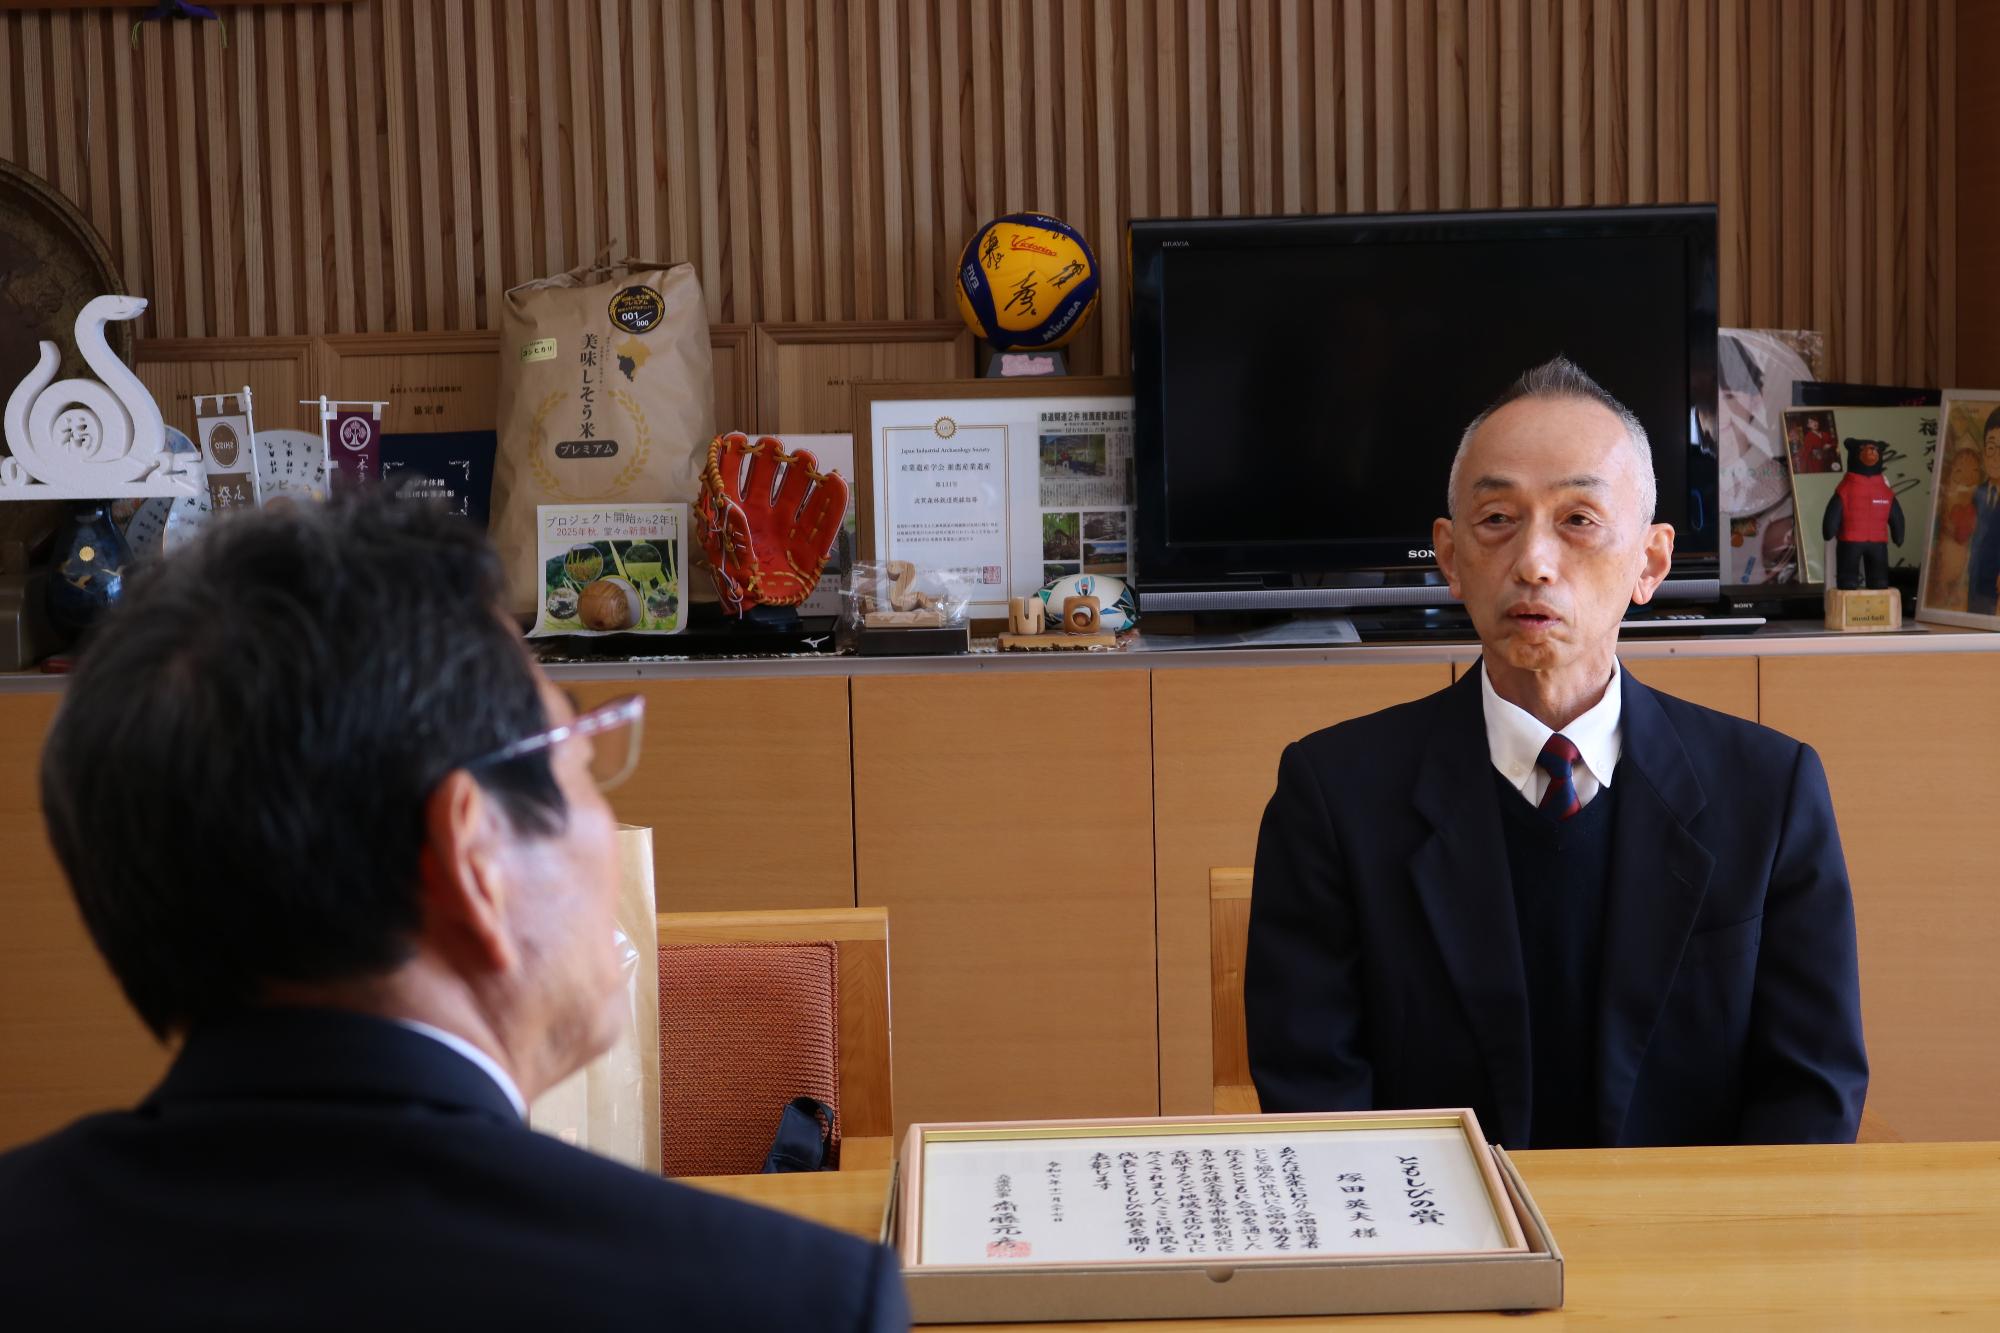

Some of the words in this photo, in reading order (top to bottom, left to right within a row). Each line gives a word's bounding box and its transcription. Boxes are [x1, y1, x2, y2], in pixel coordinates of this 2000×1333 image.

[621, 311, 639, 321] 001
[580, 333, 599, 439] 美味しそう米
[560, 443, 614, 456] プレミアム
[1408, 549, 1436, 558] SON
[1088, 1151, 1113, 1190] 表彰します
[1117, 1151, 1150, 1253] 代表してともしびの賞を贈り
[1170, 1149, 1207, 1253] 貢献するなど地域文化の向上に
[1223, 1149, 1264, 1250] 伝えるとともに合唱を通じた
[1396, 1155, 1446, 1226] ともしびの賞
